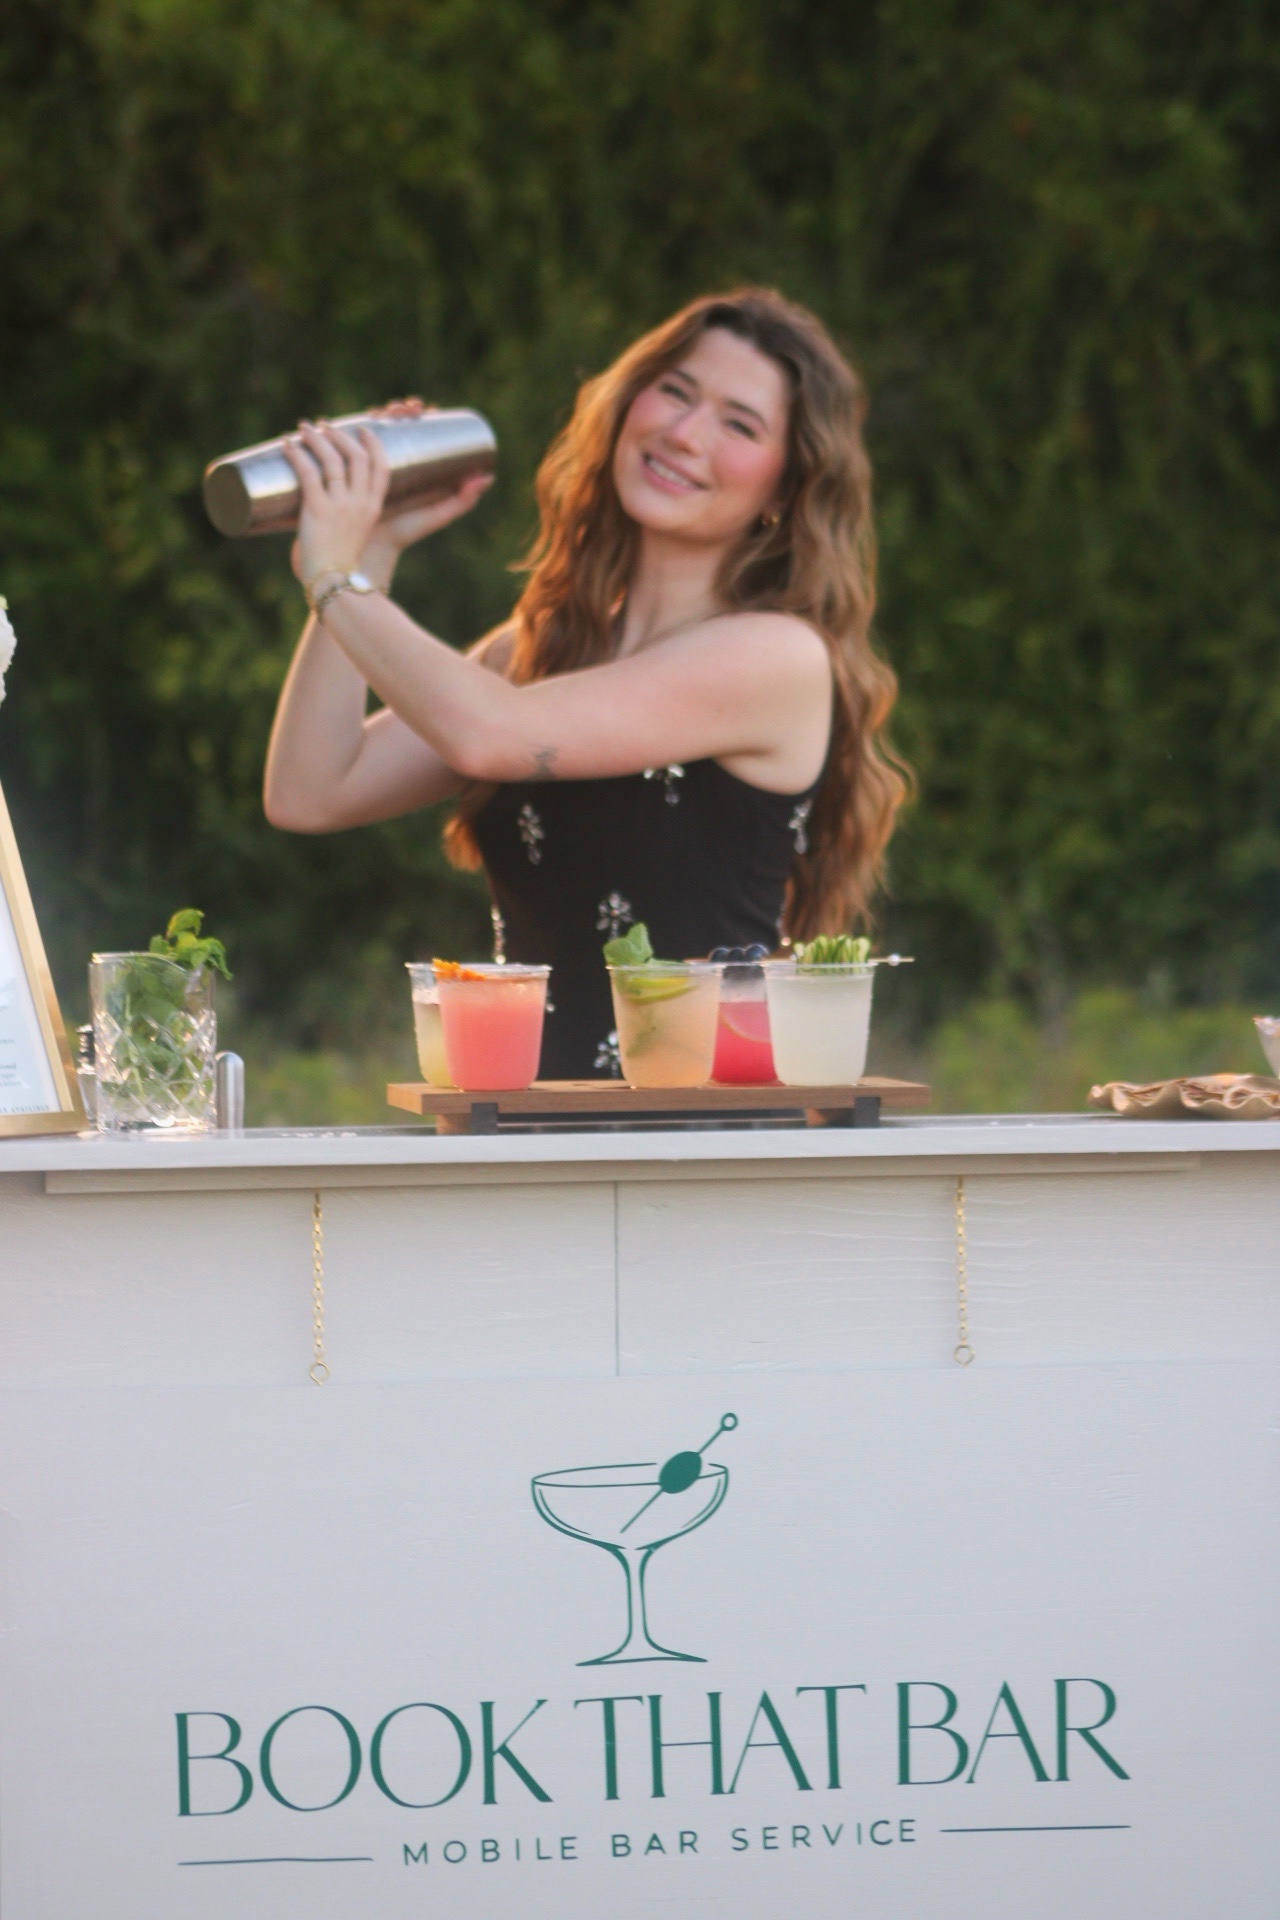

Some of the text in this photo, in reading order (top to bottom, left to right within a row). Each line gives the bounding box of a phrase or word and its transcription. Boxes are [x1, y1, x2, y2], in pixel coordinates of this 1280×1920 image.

[173, 1677, 1131, 1817] BOOK THAT BAR
[402, 1819, 917, 1866] MOBILE BAR SERVICE
